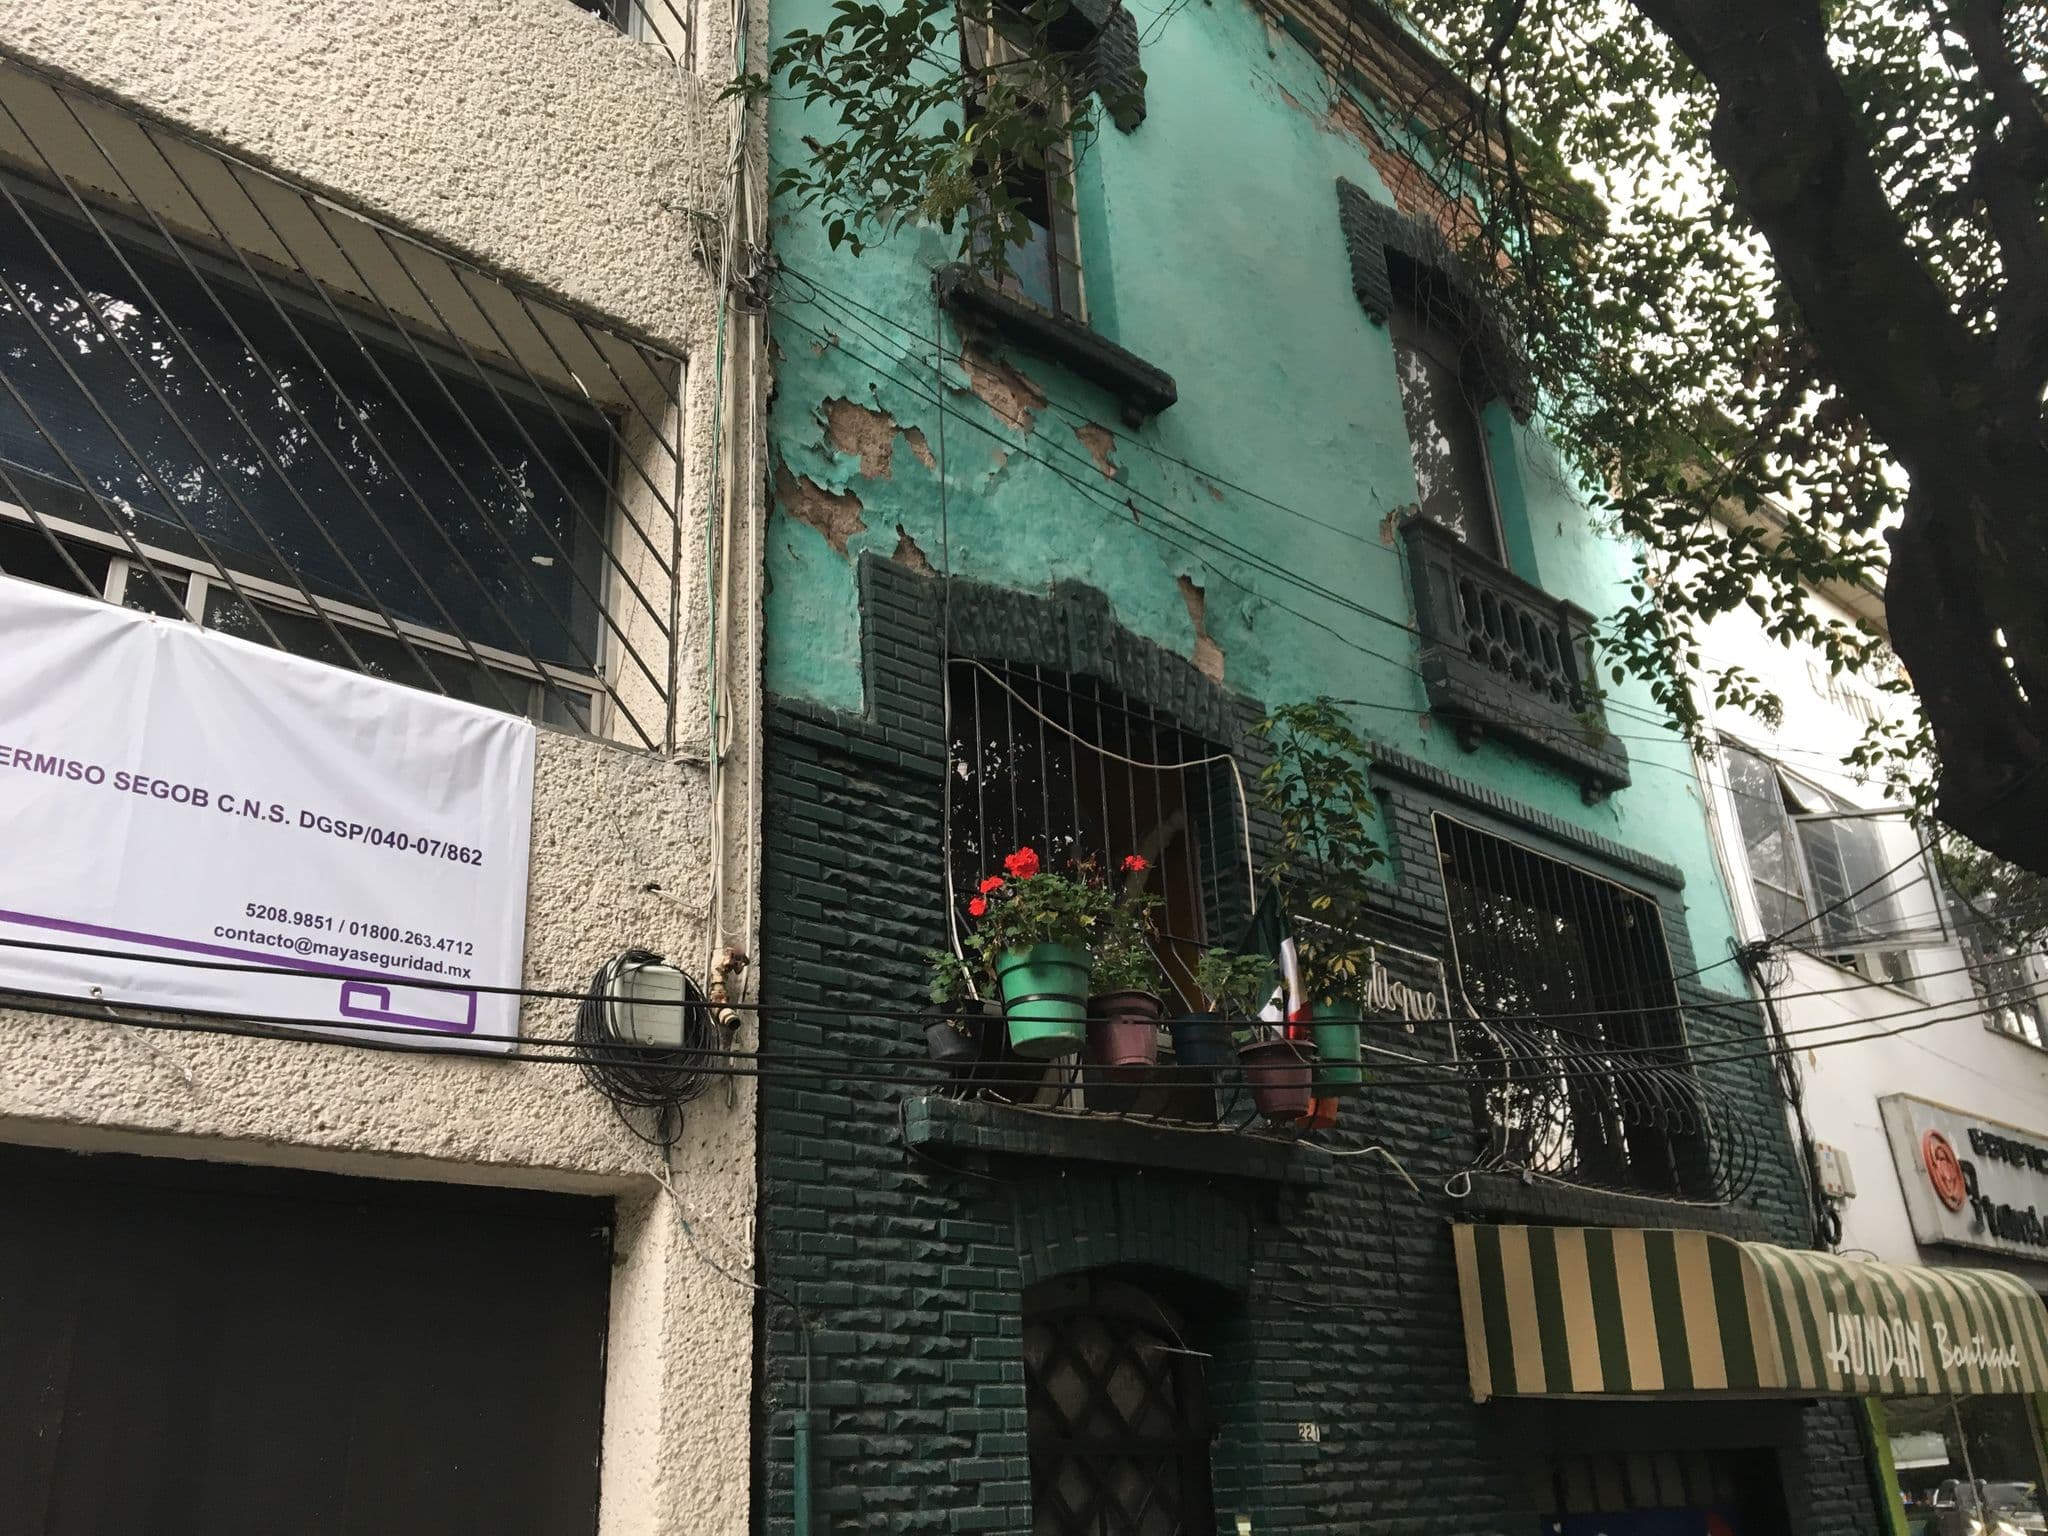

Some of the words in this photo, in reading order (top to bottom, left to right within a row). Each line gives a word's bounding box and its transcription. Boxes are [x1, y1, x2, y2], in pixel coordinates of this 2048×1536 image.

[113, 771, 209, 808] SEGOB
[217, 794, 290, 825] C.N.S.
[299, 810, 483, 866] DGSP/040-07/862
[214, 925, 472, 980] contacto@mayaseguridad.mx
[245, 903, 333, 931] 5208.9851
[338, 919, 345, 933] /
[349, 921, 474, 956] 01800.263.4712
[1827, 1312, 1925, 1378] KUNDAN
[1933, 1321, 2020, 1387] Boutique
[1299, 1424, 1319, 1441] 221
